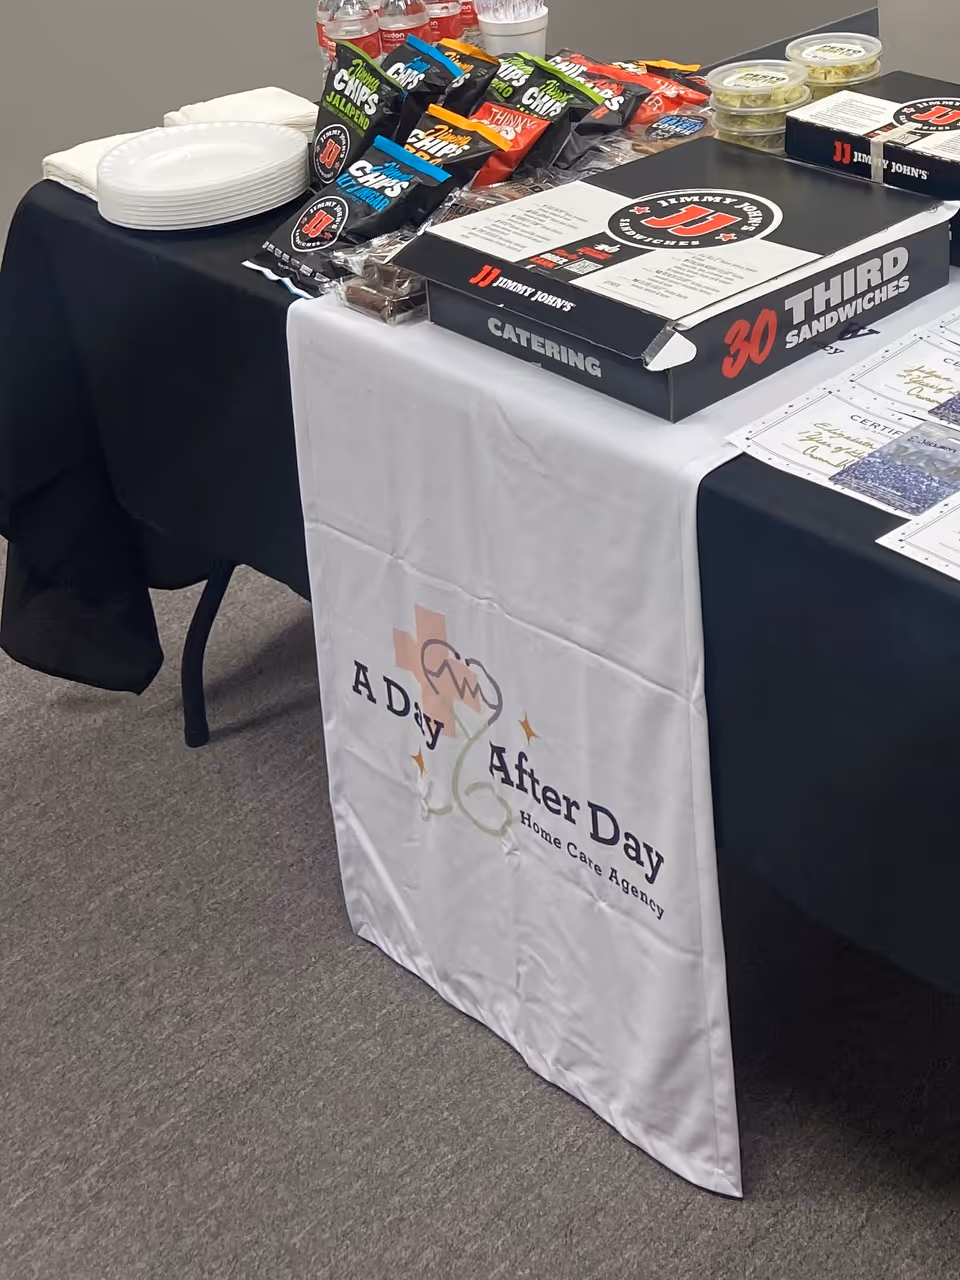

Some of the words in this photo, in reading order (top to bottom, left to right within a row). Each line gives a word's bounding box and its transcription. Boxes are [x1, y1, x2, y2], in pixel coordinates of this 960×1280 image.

[333, 68, 379, 115] CHIPS
[386, 62, 425, 90] CHIPS
[495, 63, 531, 87] HIPS
[406, 128, 471, 158] CHIPS
[348, 160, 409, 198] CHIPS
[853, 150, 889, 170] JIMY
[891, 161, 929, 180] JOHN'S
[619, 217, 701, 246] SANDWICHES
[656, 195, 739, 207] JIMMY
[733, 199, 763, 232] JOHN'S
[493, 276, 536, 298] JIMMY
[531, 290, 576, 312] JOHN'S
[784, 246, 910, 326] THIRD
[785, 275, 910, 349] SANDWICHES
[487, 317, 602, 378] CATERING
[721, 308, 778, 379] 30
[849, 414, 906, 436] CERTIF
[352, 659, 378, 705] A
[382, 674, 445, 751] Day
[488, 740, 581, 826] After
[587, 800, 665, 886] Day
[519, 810, 563, 850] Home
[566, 841, 603, 878] Care
[607, 866, 666, 921] Agency
